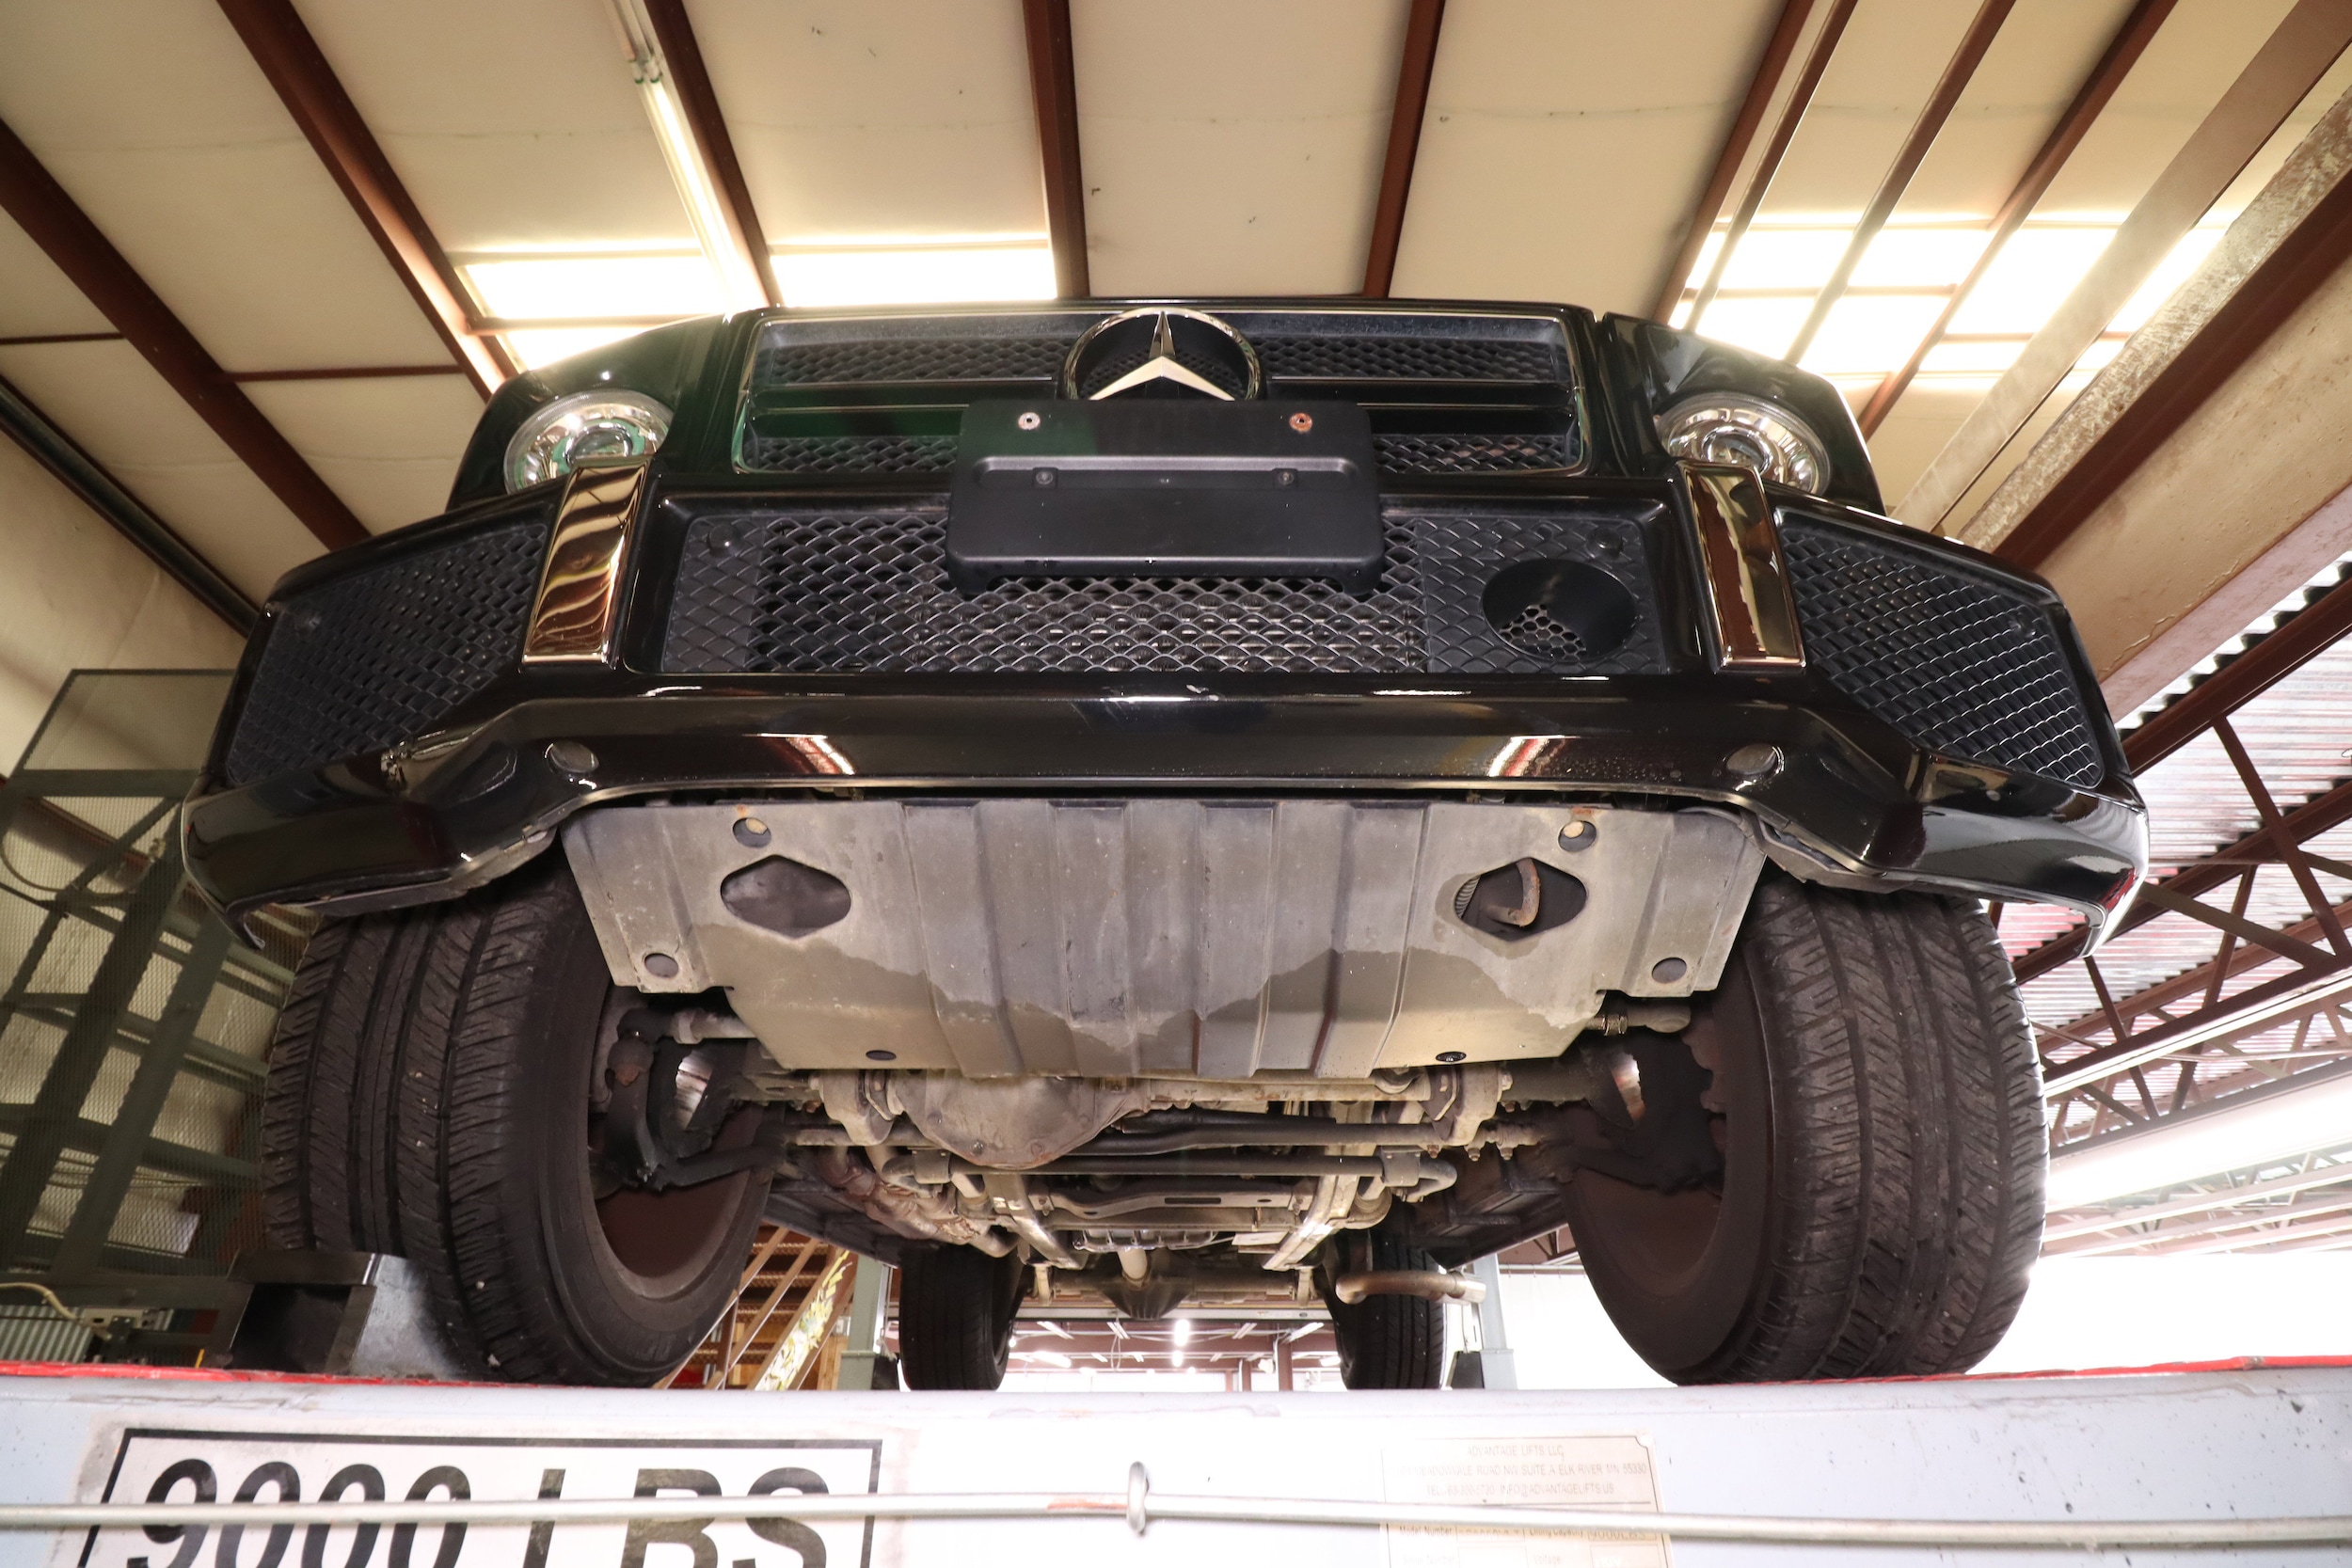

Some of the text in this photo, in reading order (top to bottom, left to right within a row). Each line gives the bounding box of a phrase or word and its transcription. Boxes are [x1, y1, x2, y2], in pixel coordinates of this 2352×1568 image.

[1467, 1444, 1518, 1457] ADVANTAGE
[1521, 1444, 1545, 1457] LIFTS
[1476, 1465, 1501, 1477] ROAD
[1503, 1465, 1519, 1476] NW
[1521, 1465, 1546, 1476] SUITE
[1558, 1464, 1576, 1476] ELK
[1578, 1464, 1603, 1475] RIVER
[1623, 1463, 1647, 1475] 55330
[126, 1458, 471, 1568] 9000
